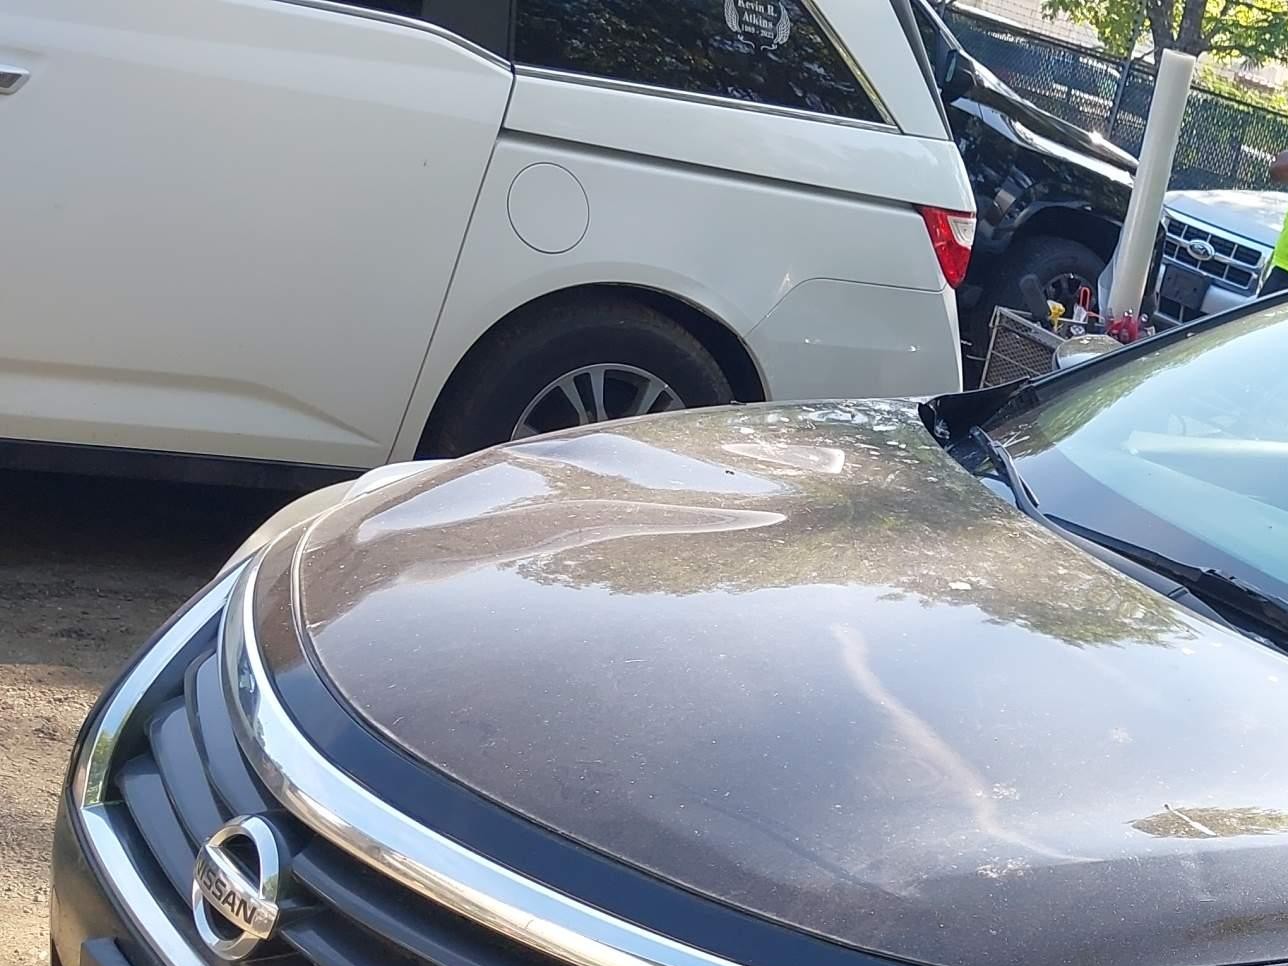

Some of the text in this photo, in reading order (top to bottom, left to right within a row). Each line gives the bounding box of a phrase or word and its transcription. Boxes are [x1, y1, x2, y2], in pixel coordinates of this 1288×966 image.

[737, 0, 765, 13] Kevin
[742, 11, 774, 28] Atkins
[195, 860, 257, 925] NISSAN
